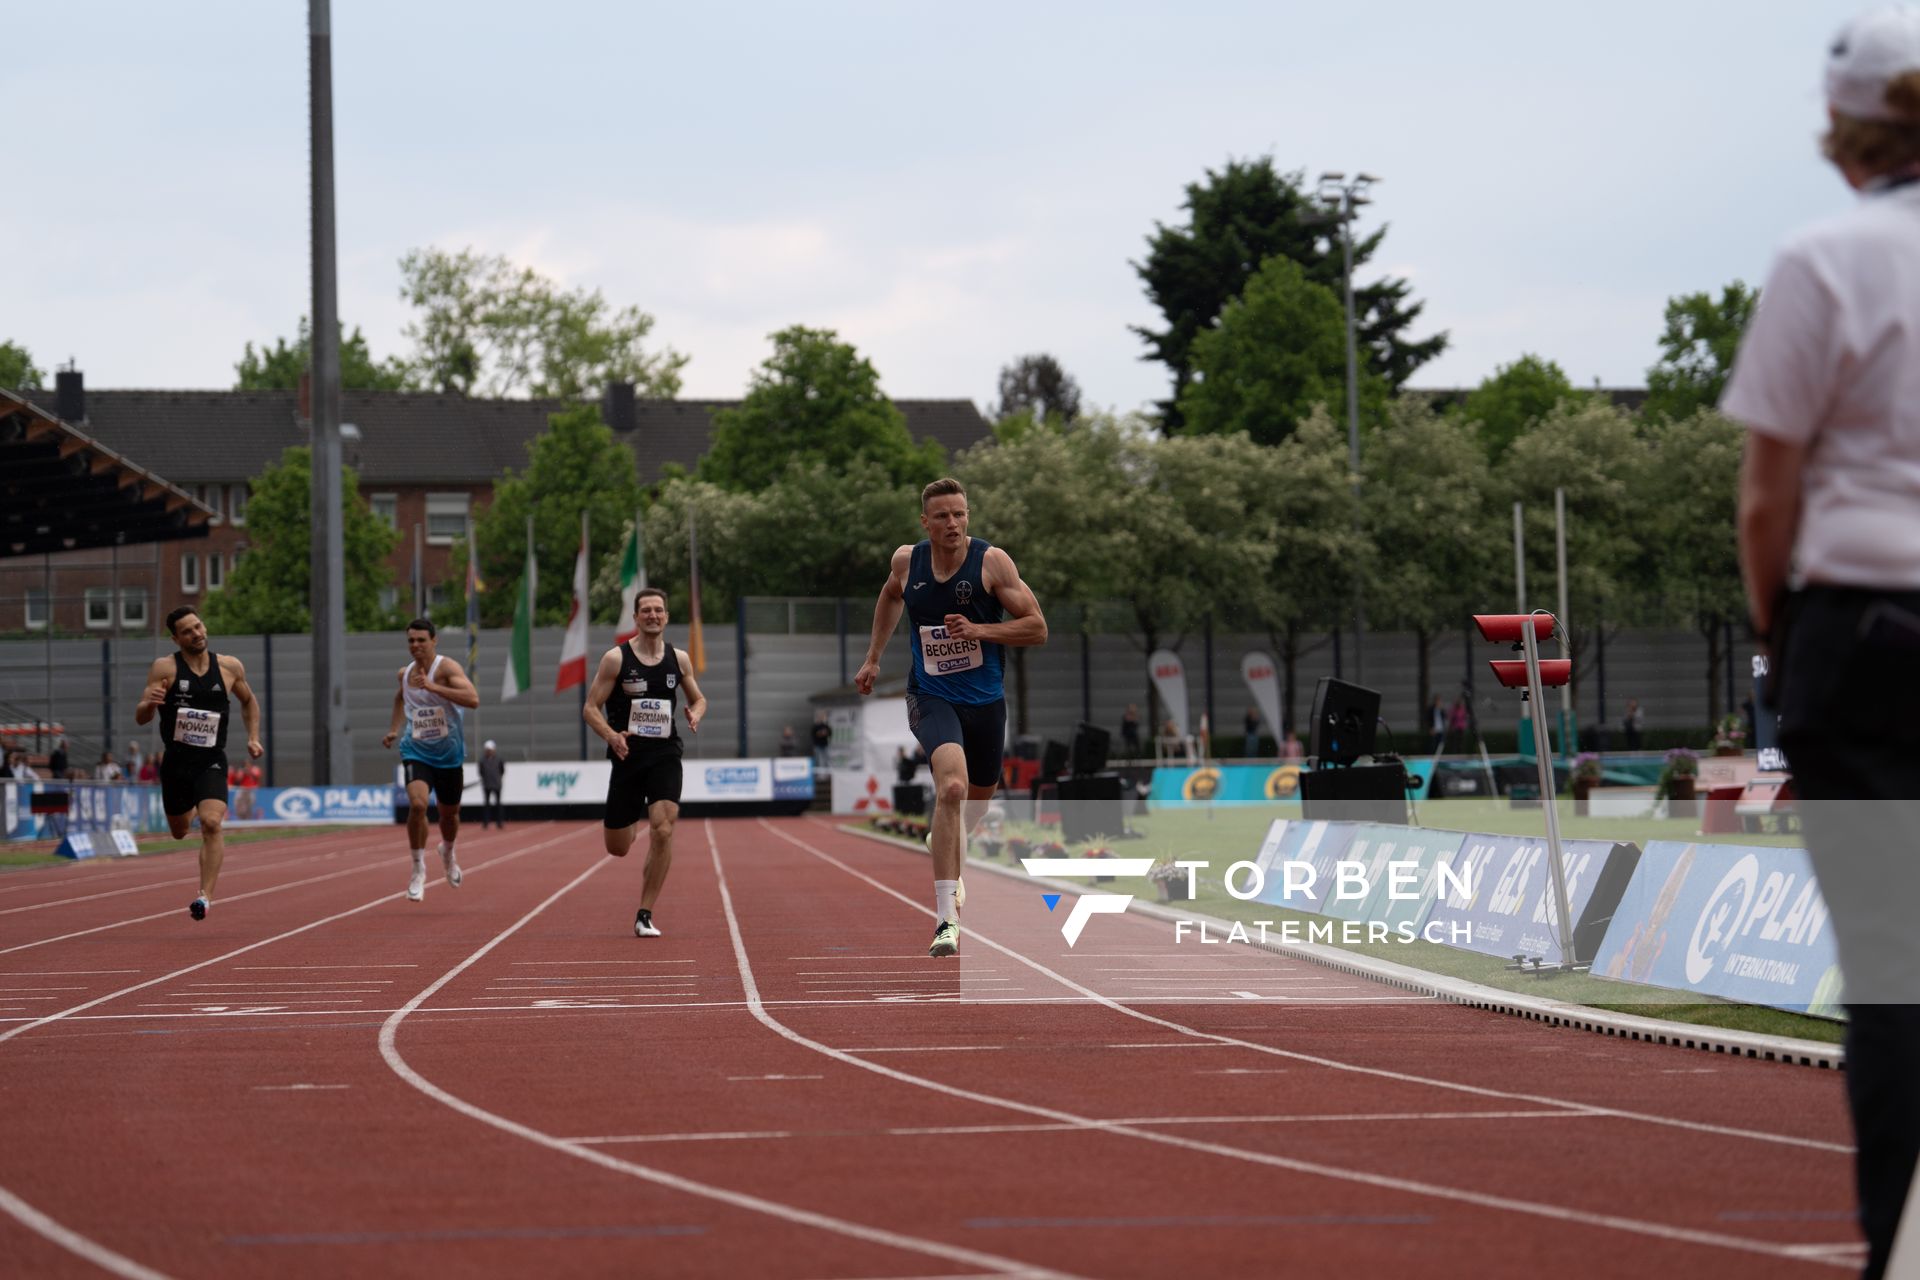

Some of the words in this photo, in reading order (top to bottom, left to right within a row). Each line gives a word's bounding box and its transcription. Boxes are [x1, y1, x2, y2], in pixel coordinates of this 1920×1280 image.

[931, 628, 951, 640] GL
[925, 640, 978, 656] BECKERS
[950, 658, 969, 667] PLAN
[640, 701, 660, 710] GLS
[187, 711, 208, 720] GLS
[418, 709, 434, 717] GLS
[632, 712, 670, 724] DIECKMANN
[178, 720, 216, 734] NOWAK
[414, 718, 445, 729] BASTIEN
[537, 771, 579, 797] wgv
[324, 789, 392, 808] PLAN
[1741, 871, 1829, 946] PLAN
[1723, 953, 1800, 985] INTERNATIONAL
